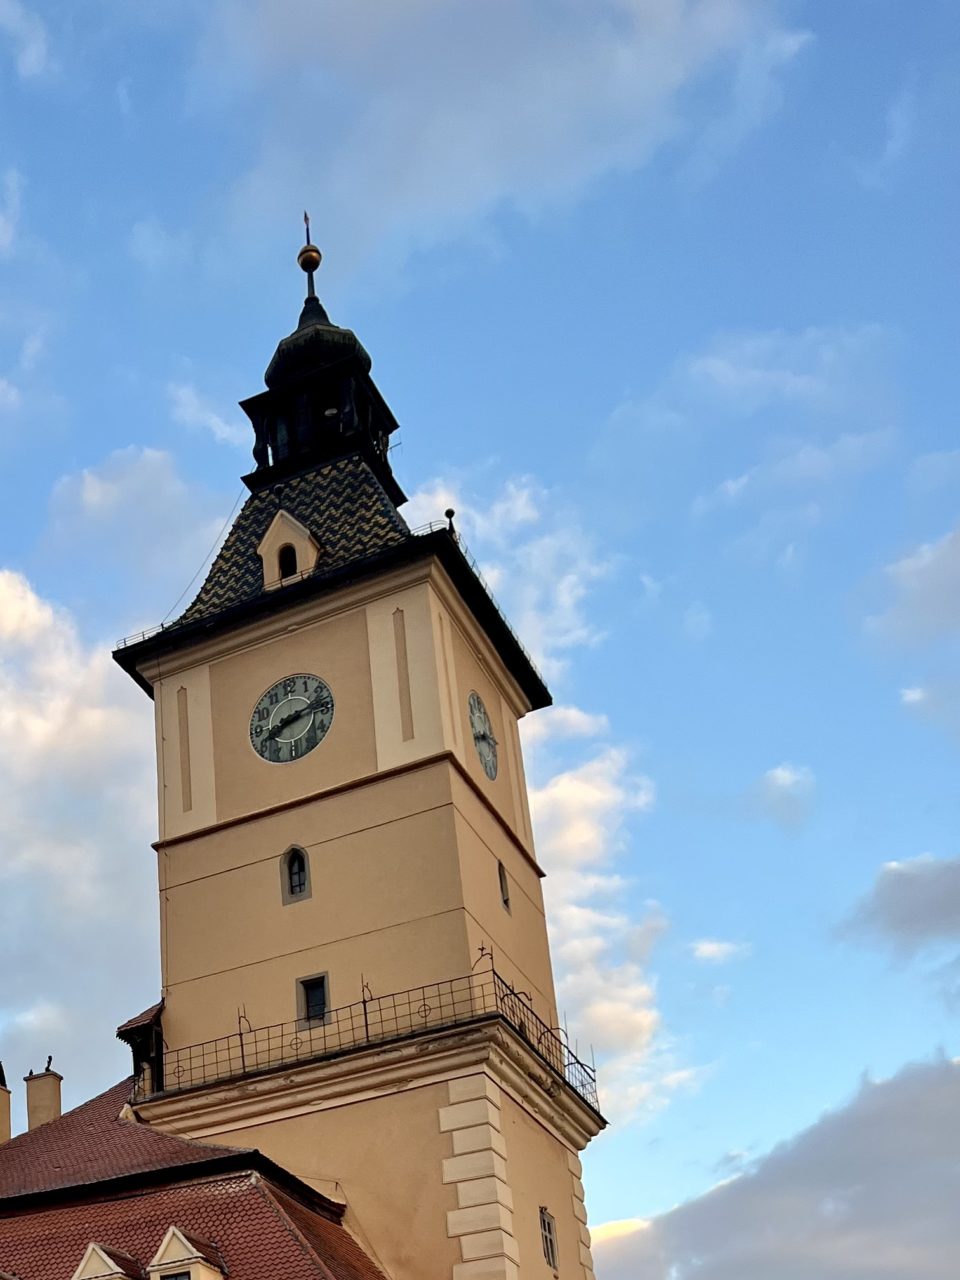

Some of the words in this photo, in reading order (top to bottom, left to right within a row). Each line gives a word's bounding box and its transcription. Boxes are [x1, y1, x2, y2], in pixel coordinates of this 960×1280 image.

[283, 680, 296, 696] 12
[302, 680, 309, 693] 1
[268, 692, 279, 705] 11
[256, 707, 270, 722] 10
[254, 724, 263, 738] 9
[317, 718, 327, 733] 4
